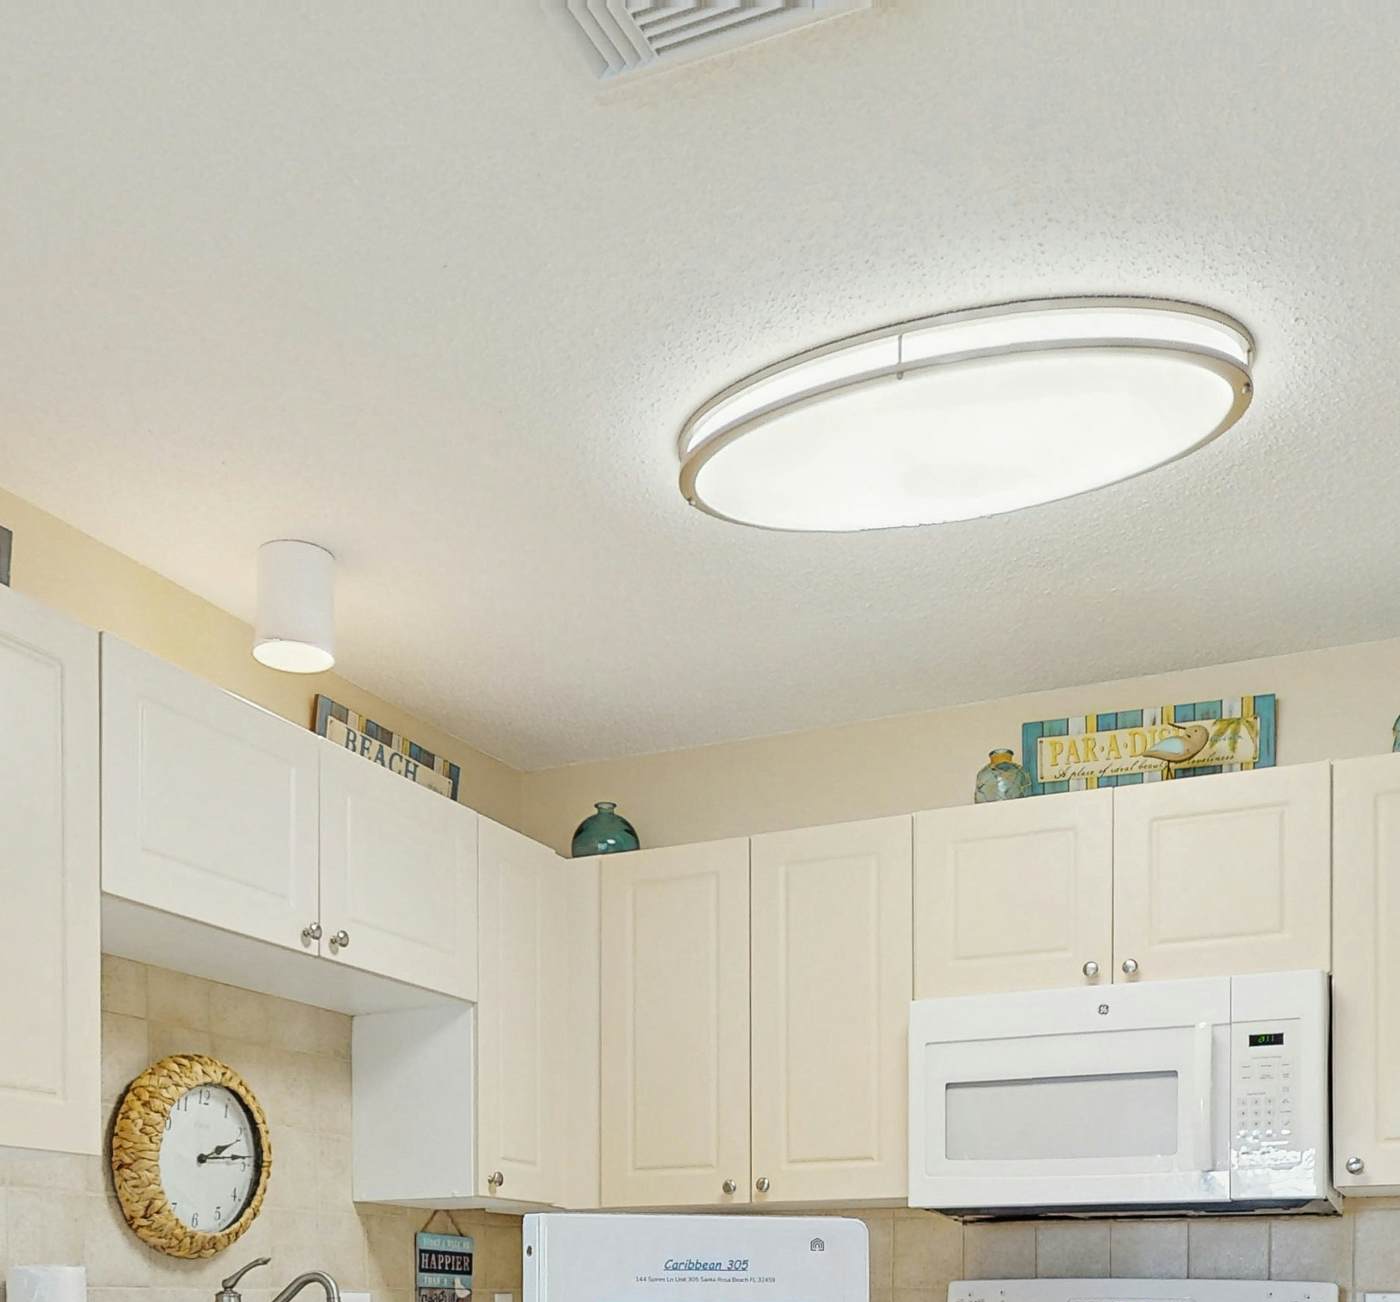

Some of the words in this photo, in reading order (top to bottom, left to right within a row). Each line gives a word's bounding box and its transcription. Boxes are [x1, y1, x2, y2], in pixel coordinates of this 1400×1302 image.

[345, 727, 419, 781] BEACH
[176, 1096, 188, 1112] 11
[198, 1089, 211, 1106] 12
[231, 1186, 238, 1202] 4
[191, 1212, 199, 1228] 6
[214, 1206, 222, 1221] 5
[421, 1252, 470, 1271] HAPPIER
[664, 1258, 722, 1271] Caribbean
[727, 1259, 749, 1271] 305
